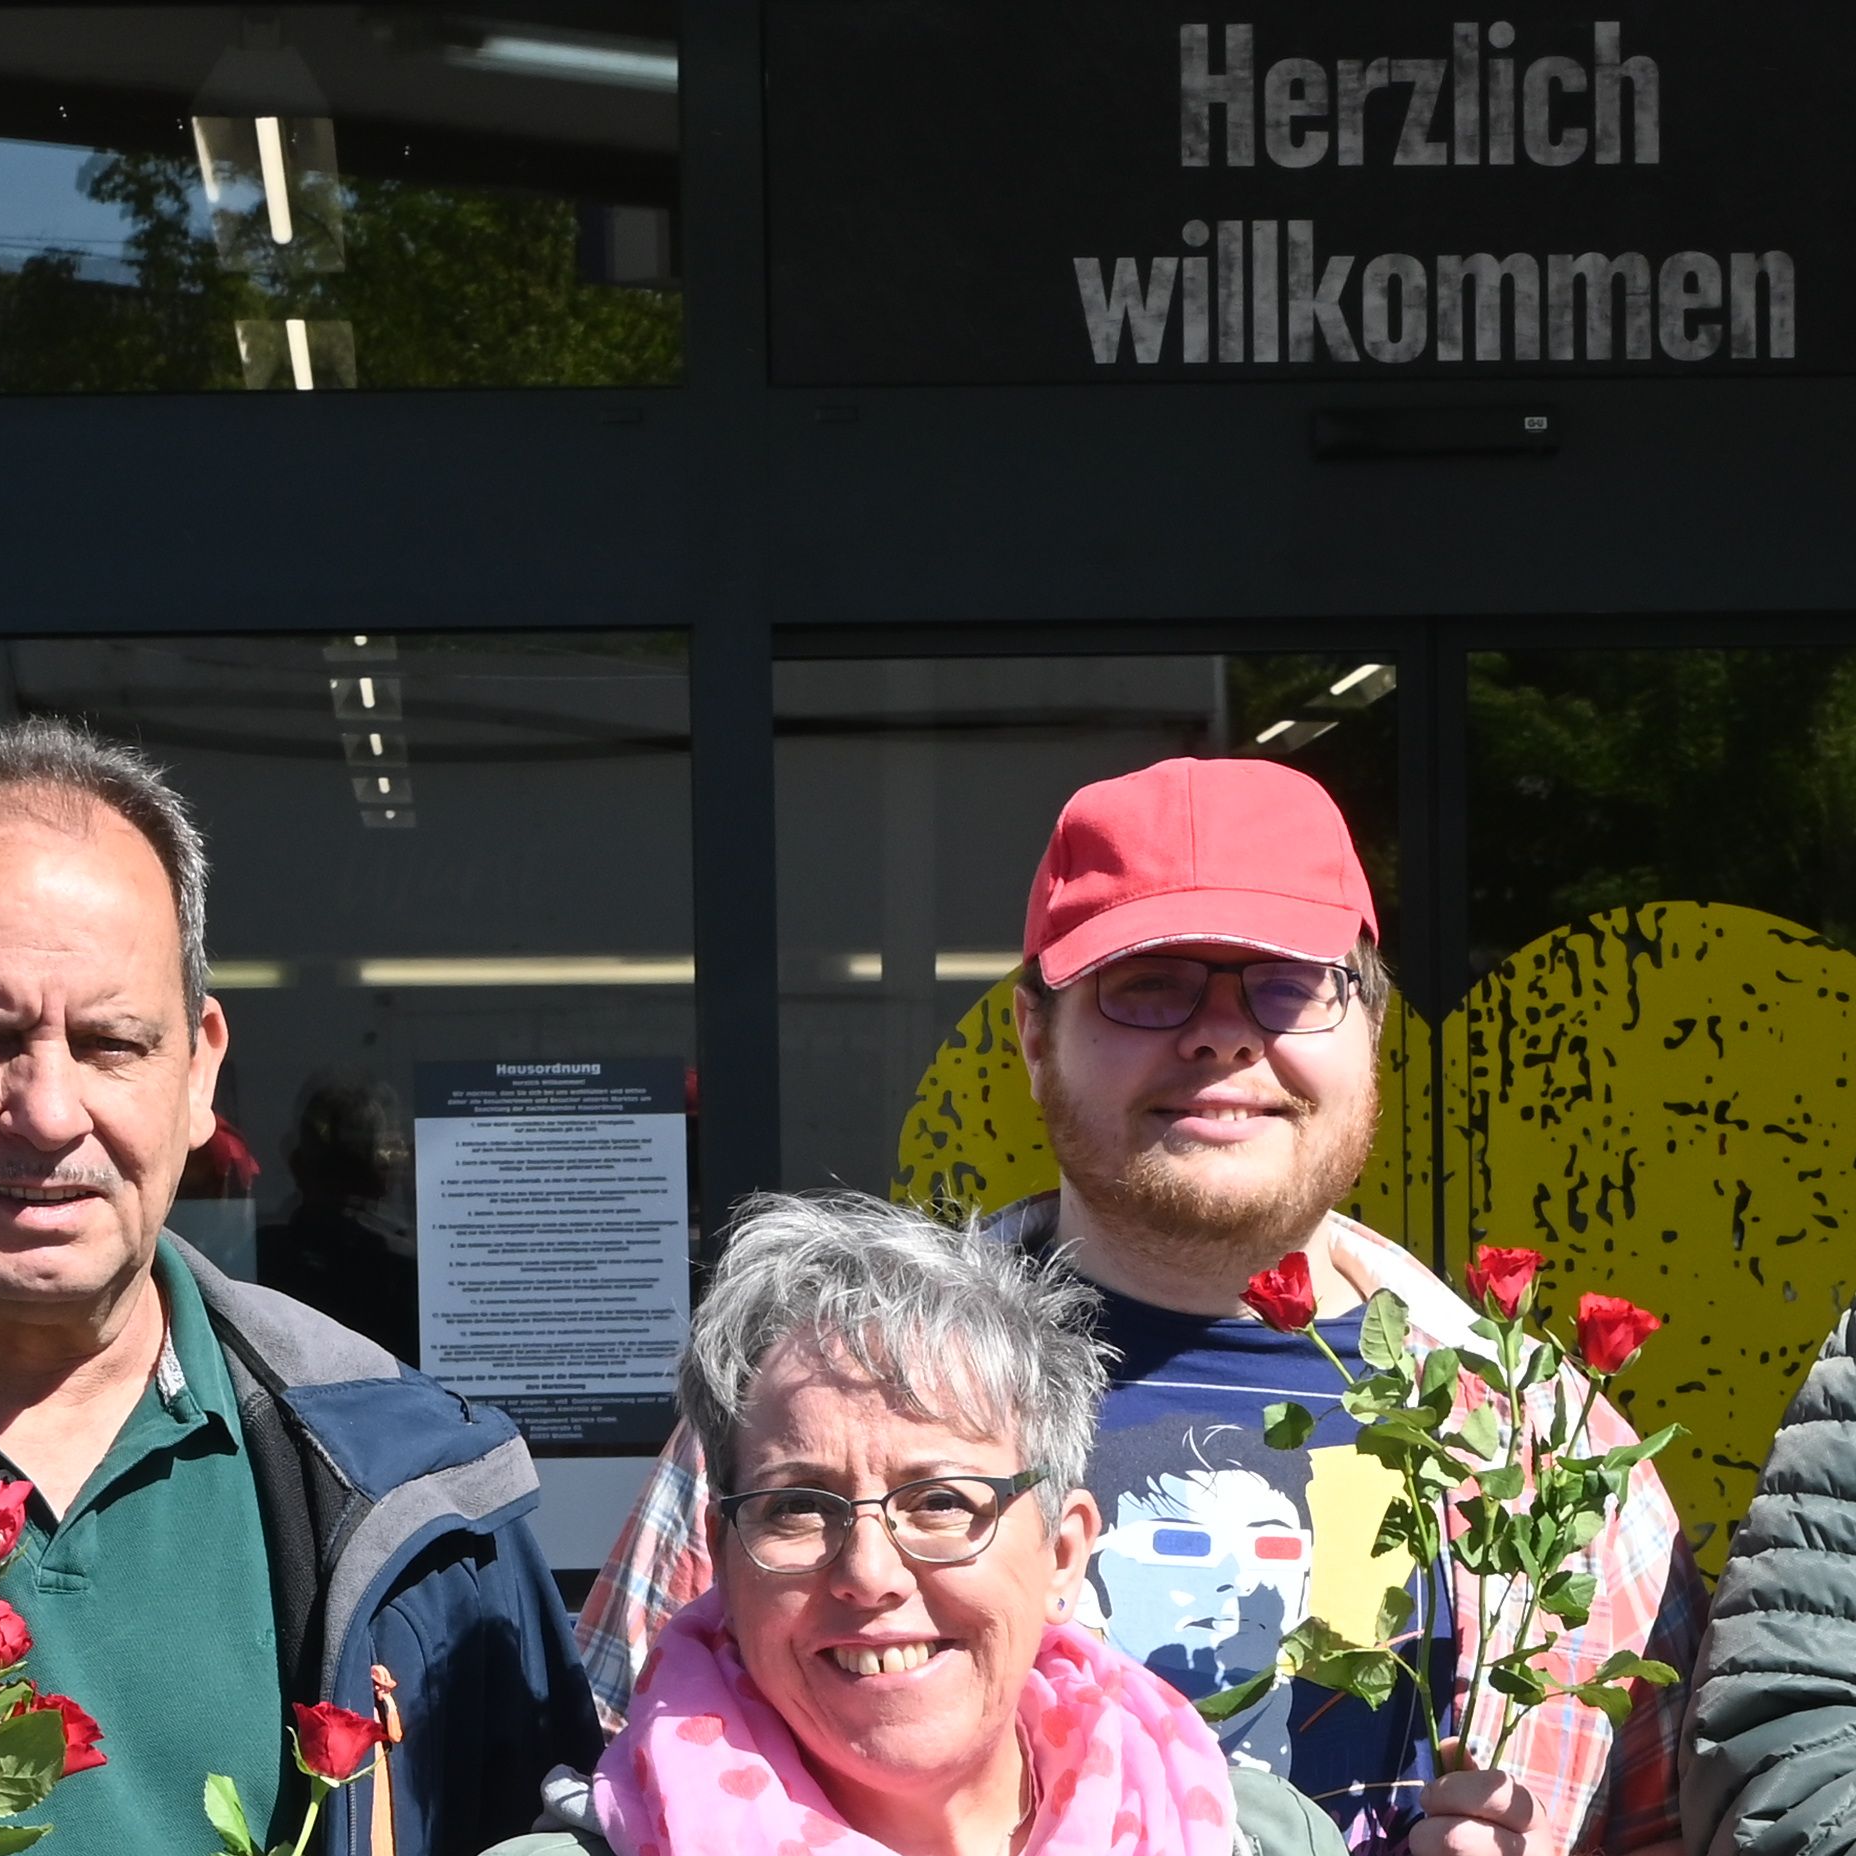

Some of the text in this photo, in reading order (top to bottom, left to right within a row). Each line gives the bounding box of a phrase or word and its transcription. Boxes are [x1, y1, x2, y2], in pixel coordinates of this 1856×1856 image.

[1179, 20, 1660, 168] Herzlich
[1073, 218, 1797, 365] willkommen
[495, 1063, 601, 1076] Hausordnung
